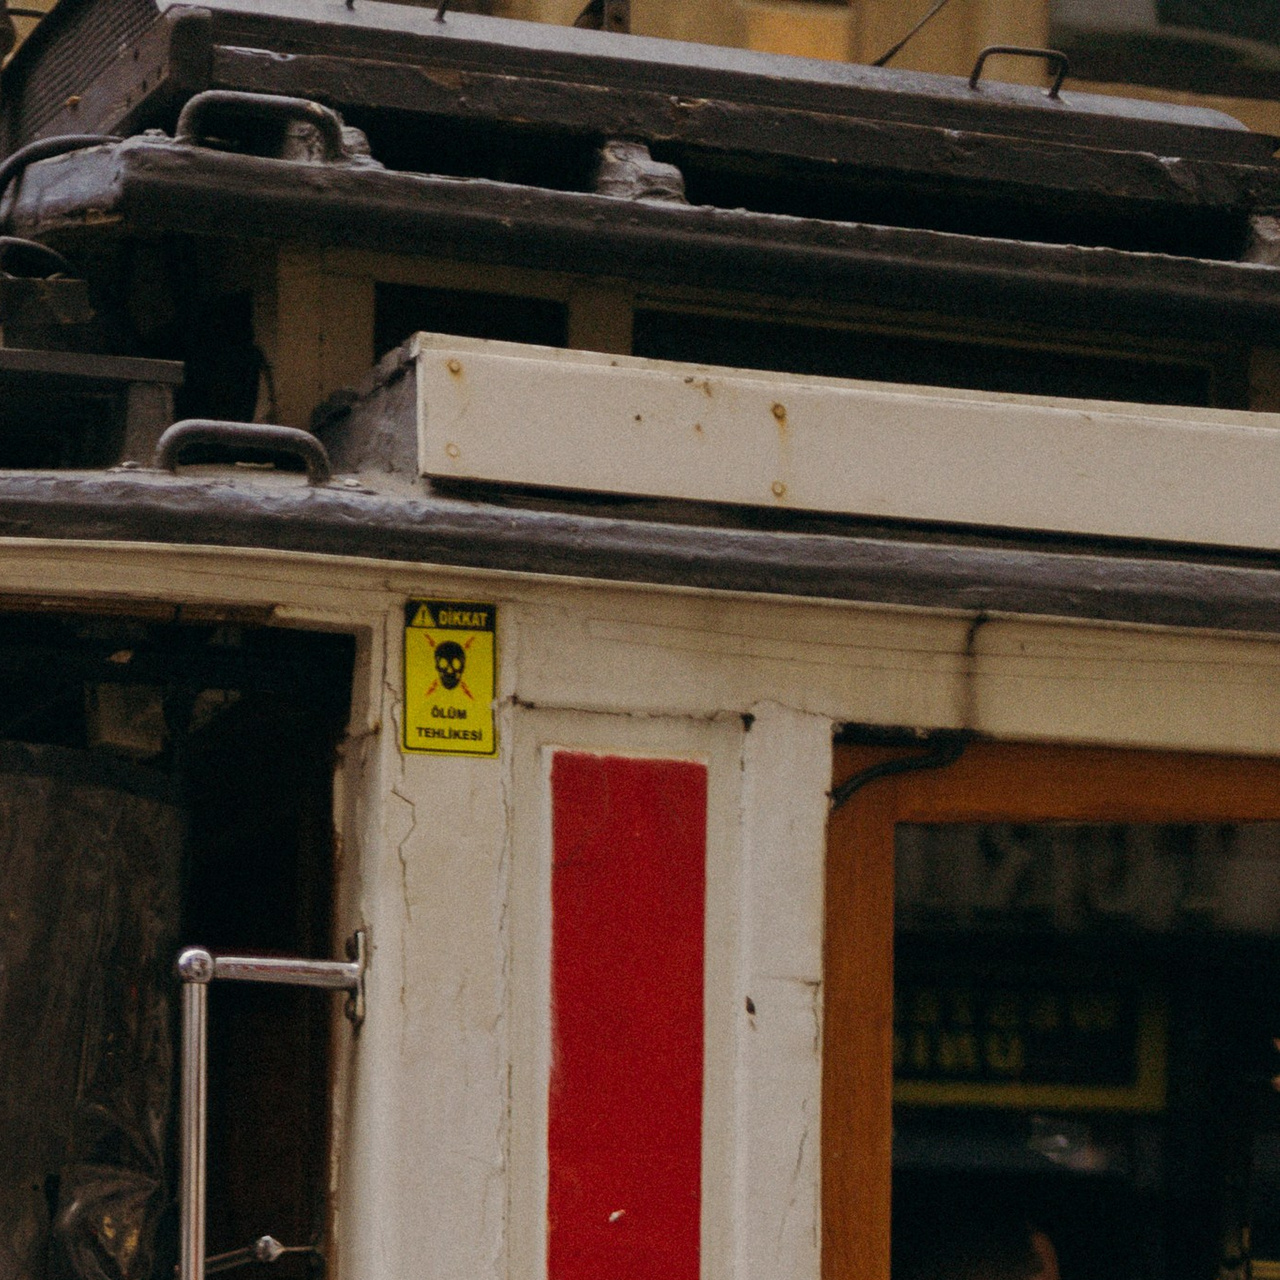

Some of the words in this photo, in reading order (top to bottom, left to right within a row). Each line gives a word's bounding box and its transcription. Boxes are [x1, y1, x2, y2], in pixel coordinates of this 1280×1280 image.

[438, 607, 488, 627] DİKKAT
[431, 705, 468, 720] ÖLÜM
[416, 726, 483, 742] TEHLİKESİ
